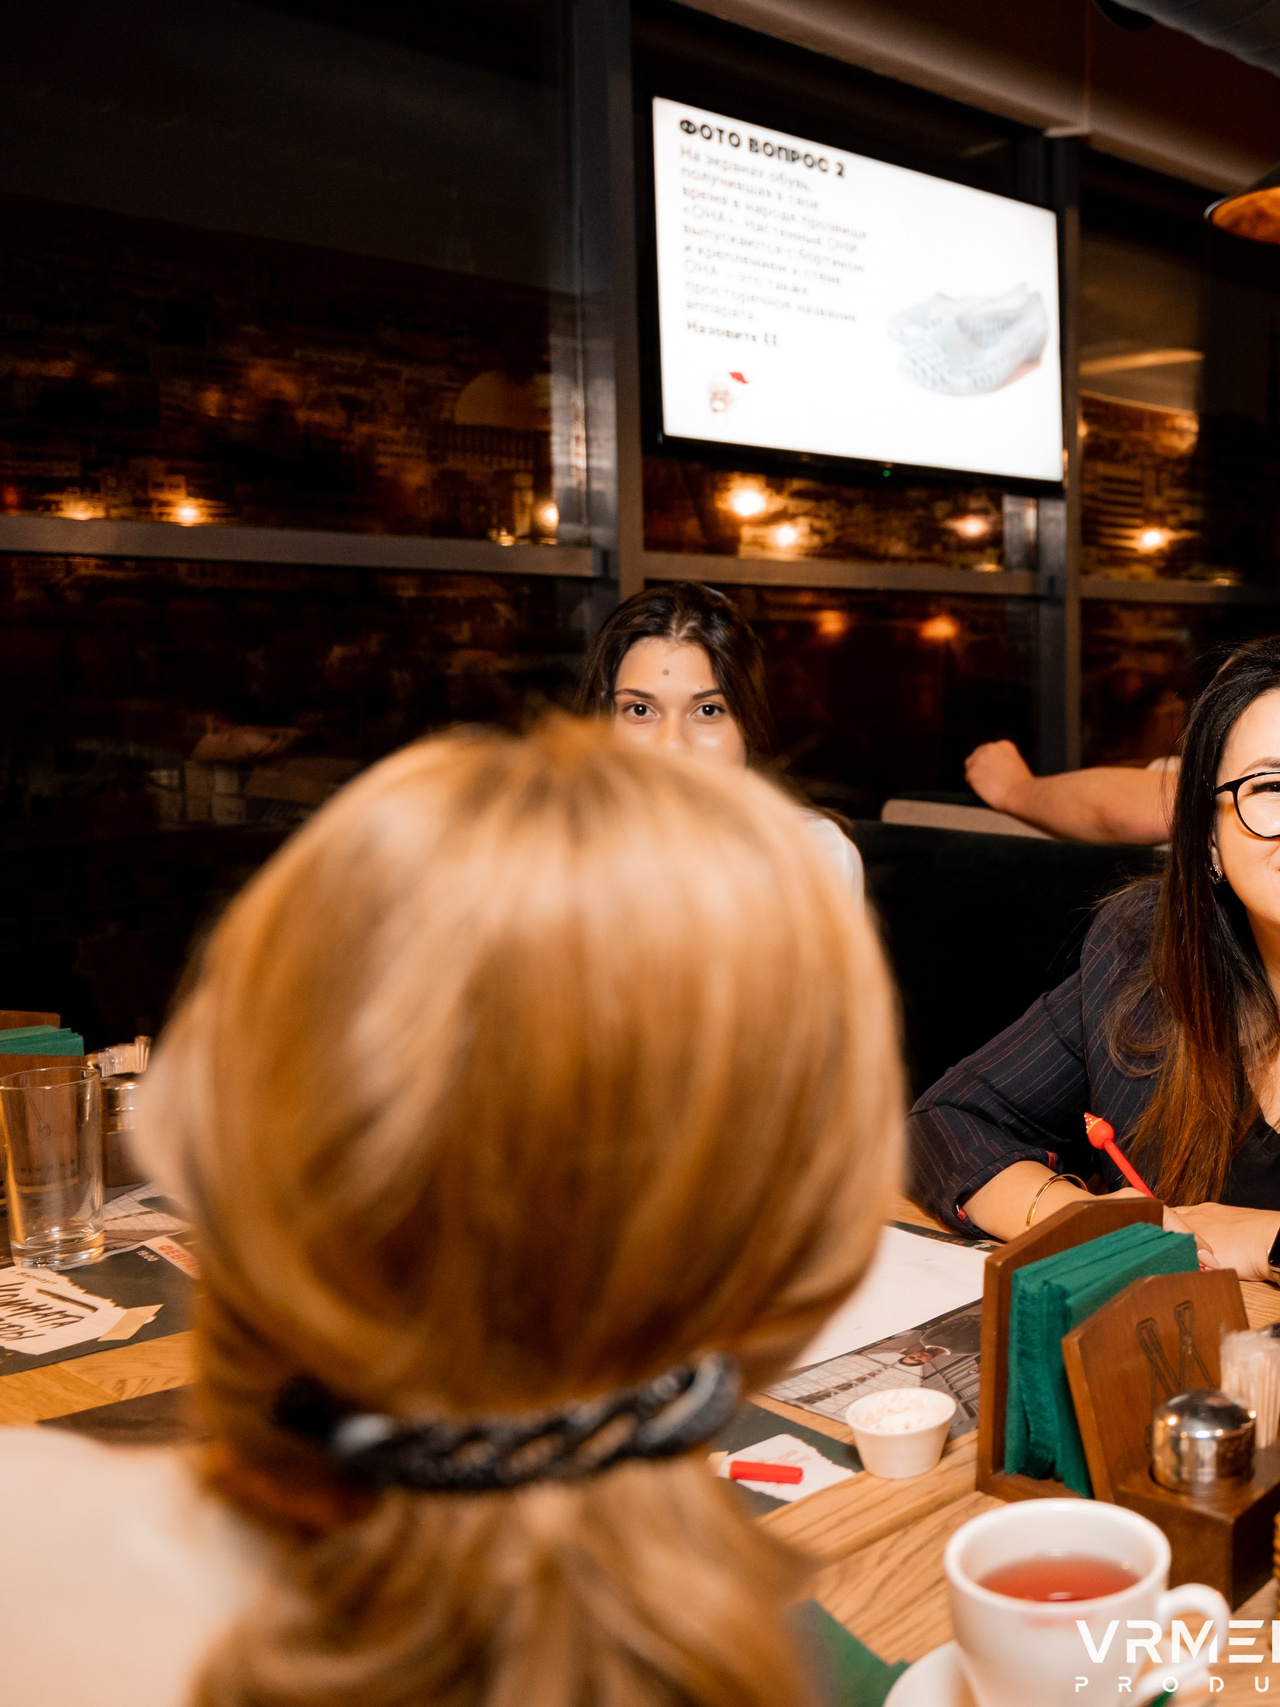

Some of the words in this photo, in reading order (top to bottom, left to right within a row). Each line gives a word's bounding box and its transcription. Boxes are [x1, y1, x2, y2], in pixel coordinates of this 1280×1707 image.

[680, 118, 741, 148] ФОТО
[748, 137, 829, 173] ВОПРОС
[835, 161, 846, 178] 2
[680, 144, 700, 162] На
[680, 166, 772, 198] получившая
[681, 186, 728, 206] время
[745, 203, 796, 223] народе
[803, 217, 868, 240] прозвище
[682, 224, 782, 255] выпускаются
[799, 248, 865, 272] бортиком
[744, 219, 821, 246] Настенные
[827, 237, 857, 254] ОНИ
[684, 258, 718, 276] ОНА
[767, 278, 810, 295] также
[697, 247, 786, 272] креплением
[684, 280, 791, 310] просторечное
[797, 303, 857, 322] название
[686, 318, 758, 344] Назовите
